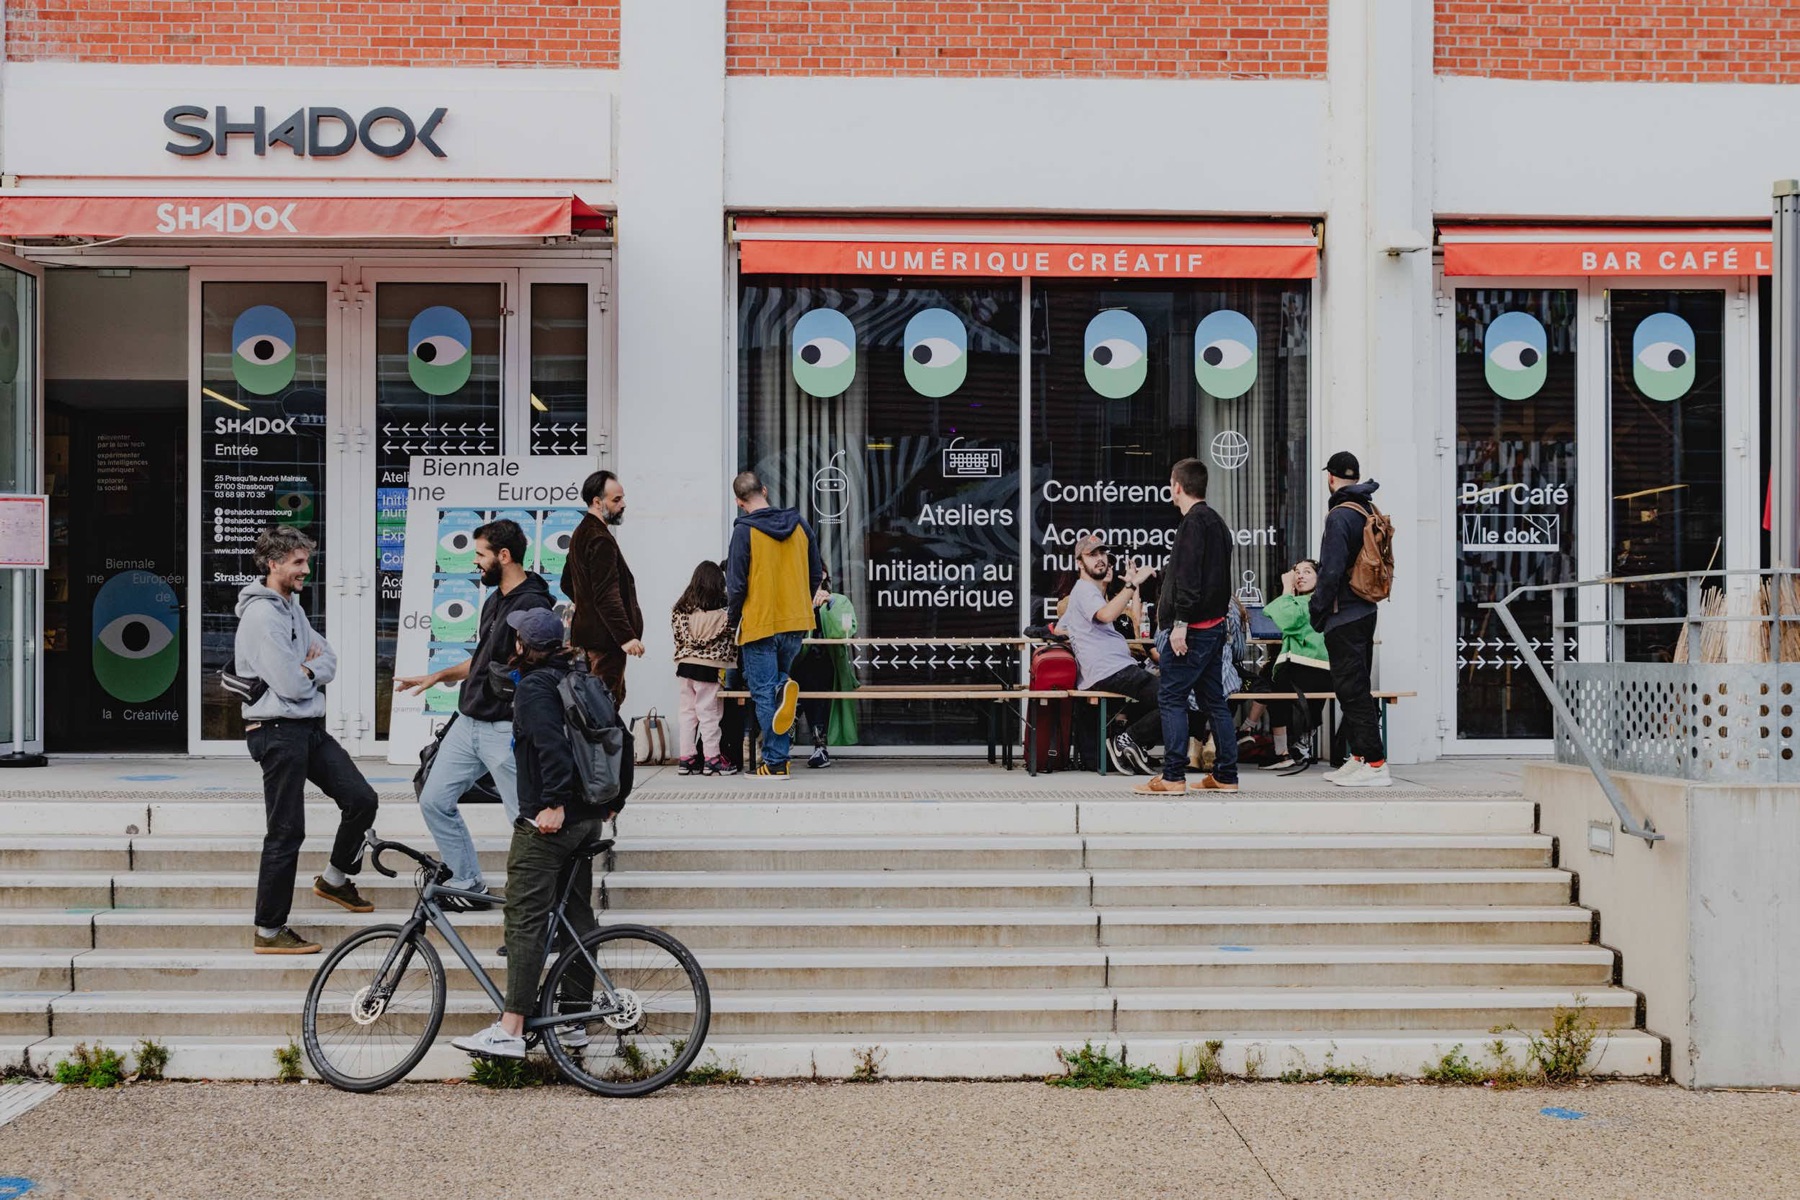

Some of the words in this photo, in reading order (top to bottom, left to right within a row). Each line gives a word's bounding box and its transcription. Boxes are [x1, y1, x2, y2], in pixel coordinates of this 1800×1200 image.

[163, 105, 448, 158] SHADOK
[156, 203, 298, 233] SHADOK
[856, 248, 1050, 273] NUMÉRIQUE
[1067, 250, 1203, 273] CRÉATIF
[1581, 251, 1642, 271] BAR
[1658, 248, 1738, 270] CAFÉ
[1755, 251, 1770, 270] L
[214, 416, 297, 435] SHADOK
[215, 444, 259, 456] Entrée
[423, 458, 519, 476] Biennale
[214, 474, 224, 482] 25
[259, 474, 279, 482] André
[381, 471, 410, 483] Ateli
[236, 483, 274, 492] Strasbourg
[498, 482, 579, 505] Europé
[1043, 480, 1172, 502] Conférenc
[1462, 483, 1504, 505] Bar
[1510, 483, 1569, 505] Café
[917, 503, 1013, 526] Ateliers
[1482, 527, 1500, 543] le
[1503, 527, 1542, 544] dok
[214, 547, 256, 555] www.shadok
[105, 558, 155, 569] Biennale
[868, 559, 976, 581] Initiation
[982, 563, 1013, 581] au
[155, 591, 171, 602] de
[877, 585, 1014, 612] numérique
[403, 611, 432, 630] de
[103, 708, 112, 719] la
[123, 709, 179, 721] Créativité
